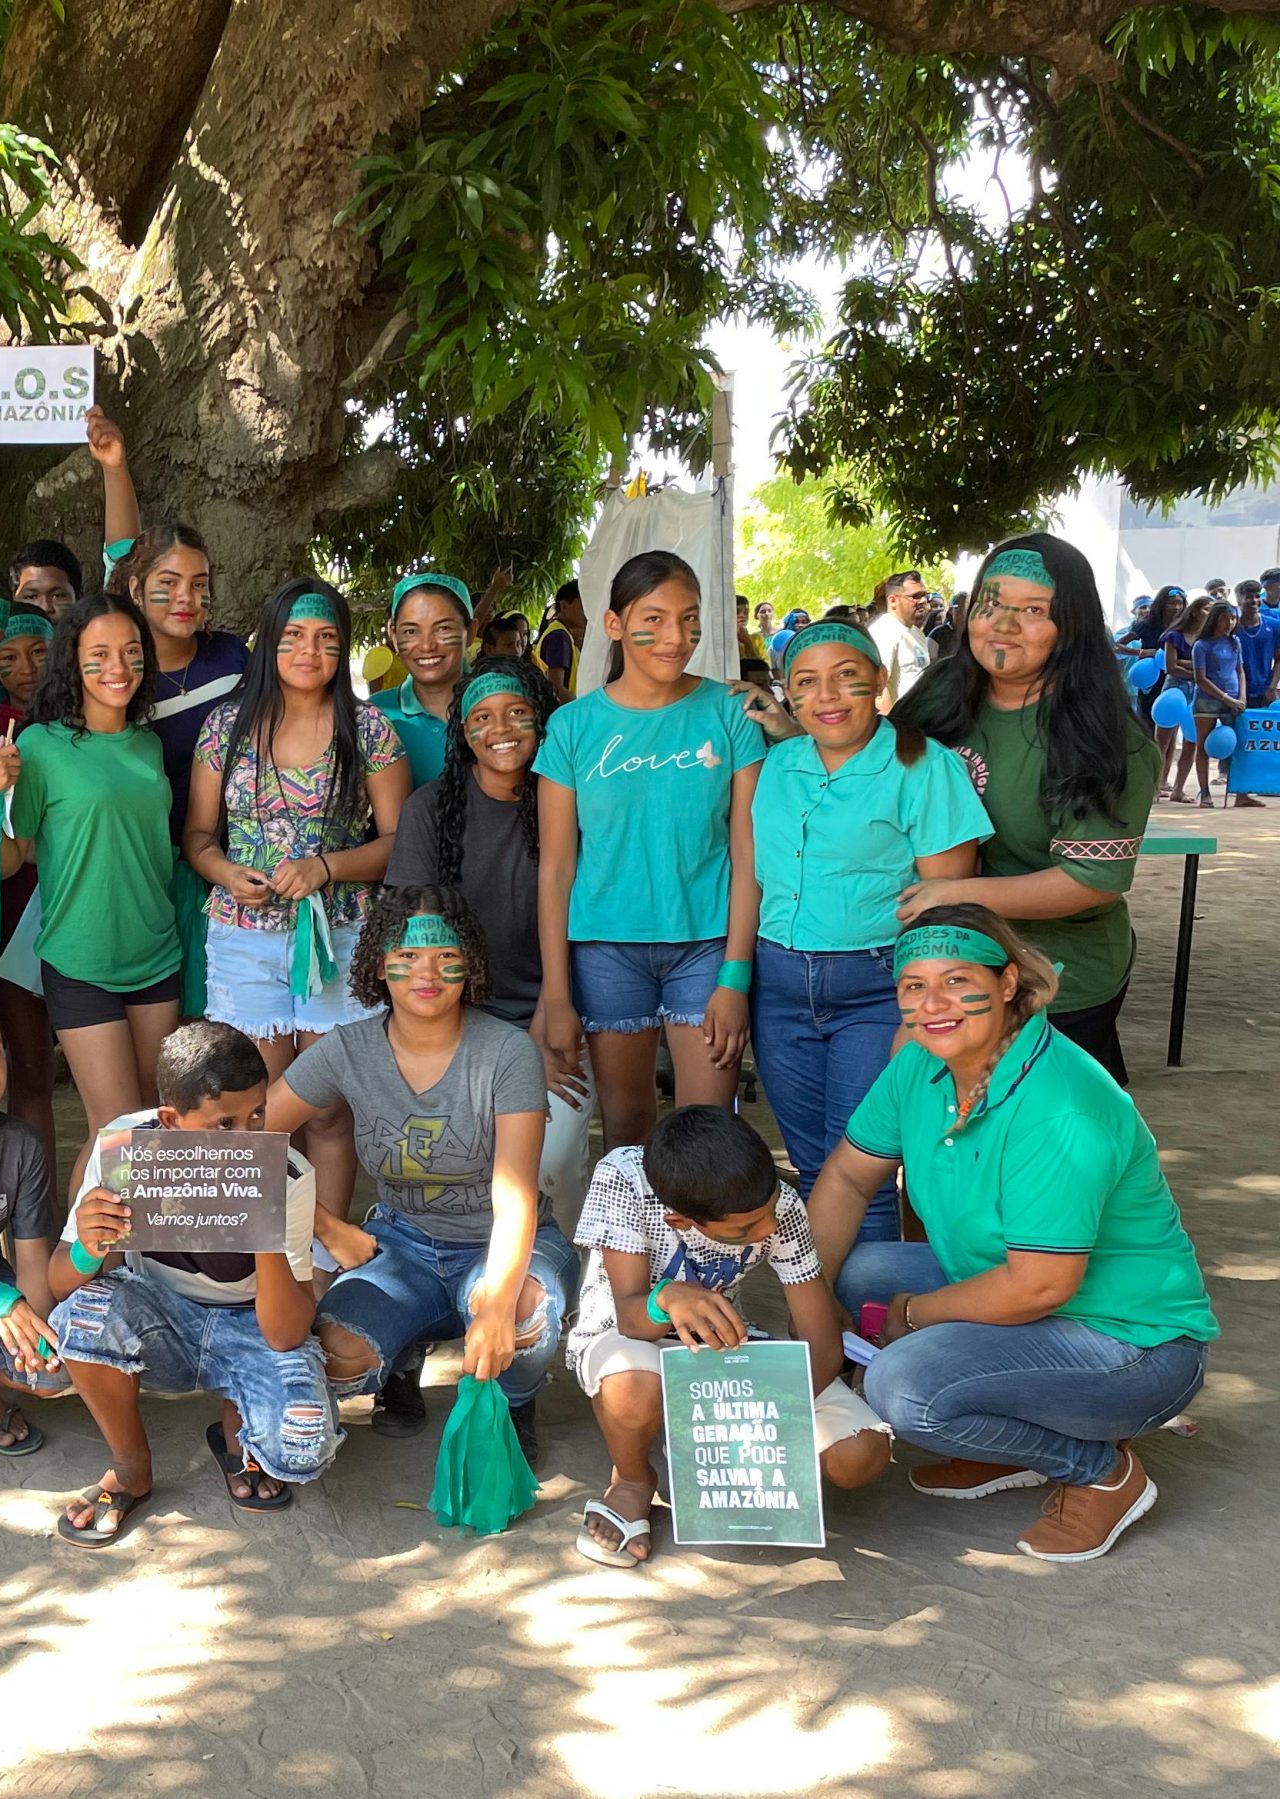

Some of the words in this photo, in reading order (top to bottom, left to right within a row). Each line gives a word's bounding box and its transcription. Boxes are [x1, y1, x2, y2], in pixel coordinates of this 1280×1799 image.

[585, 734, 705, 783] love
[120, 1146, 153, 1162] Nós
[156, 1146, 254, 1161] escolhemos
[120, 1168, 150, 1181] nos
[153, 1166, 222, 1183] importar
[224, 1167, 261, 1179] com
[120, 1187, 131, 1199] a
[133, 1183, 218, 1198] Amazônia
[221, 1183, 263, 1198] Viva.
[146, 1212, 195, 1226] Vamos
[195, 1212, 248, 1229] juntos?
[689, 1379, 754, 1400] SOMOS
[691, 1403, 705, 1422] A
[713, 1396, 780, 1420] ÚLTIMA
[692, 1419, 778, 1447] GERAÇÃO
[695, 1446, 730, 1467] QUE
[739, 1446, 788, 1465] PODE
[696, 1468, 764, 1487] SALVAR
[772, 1468, 787, 1487] A
[699, 1484, 800, 1510] AMAZÔNIA
